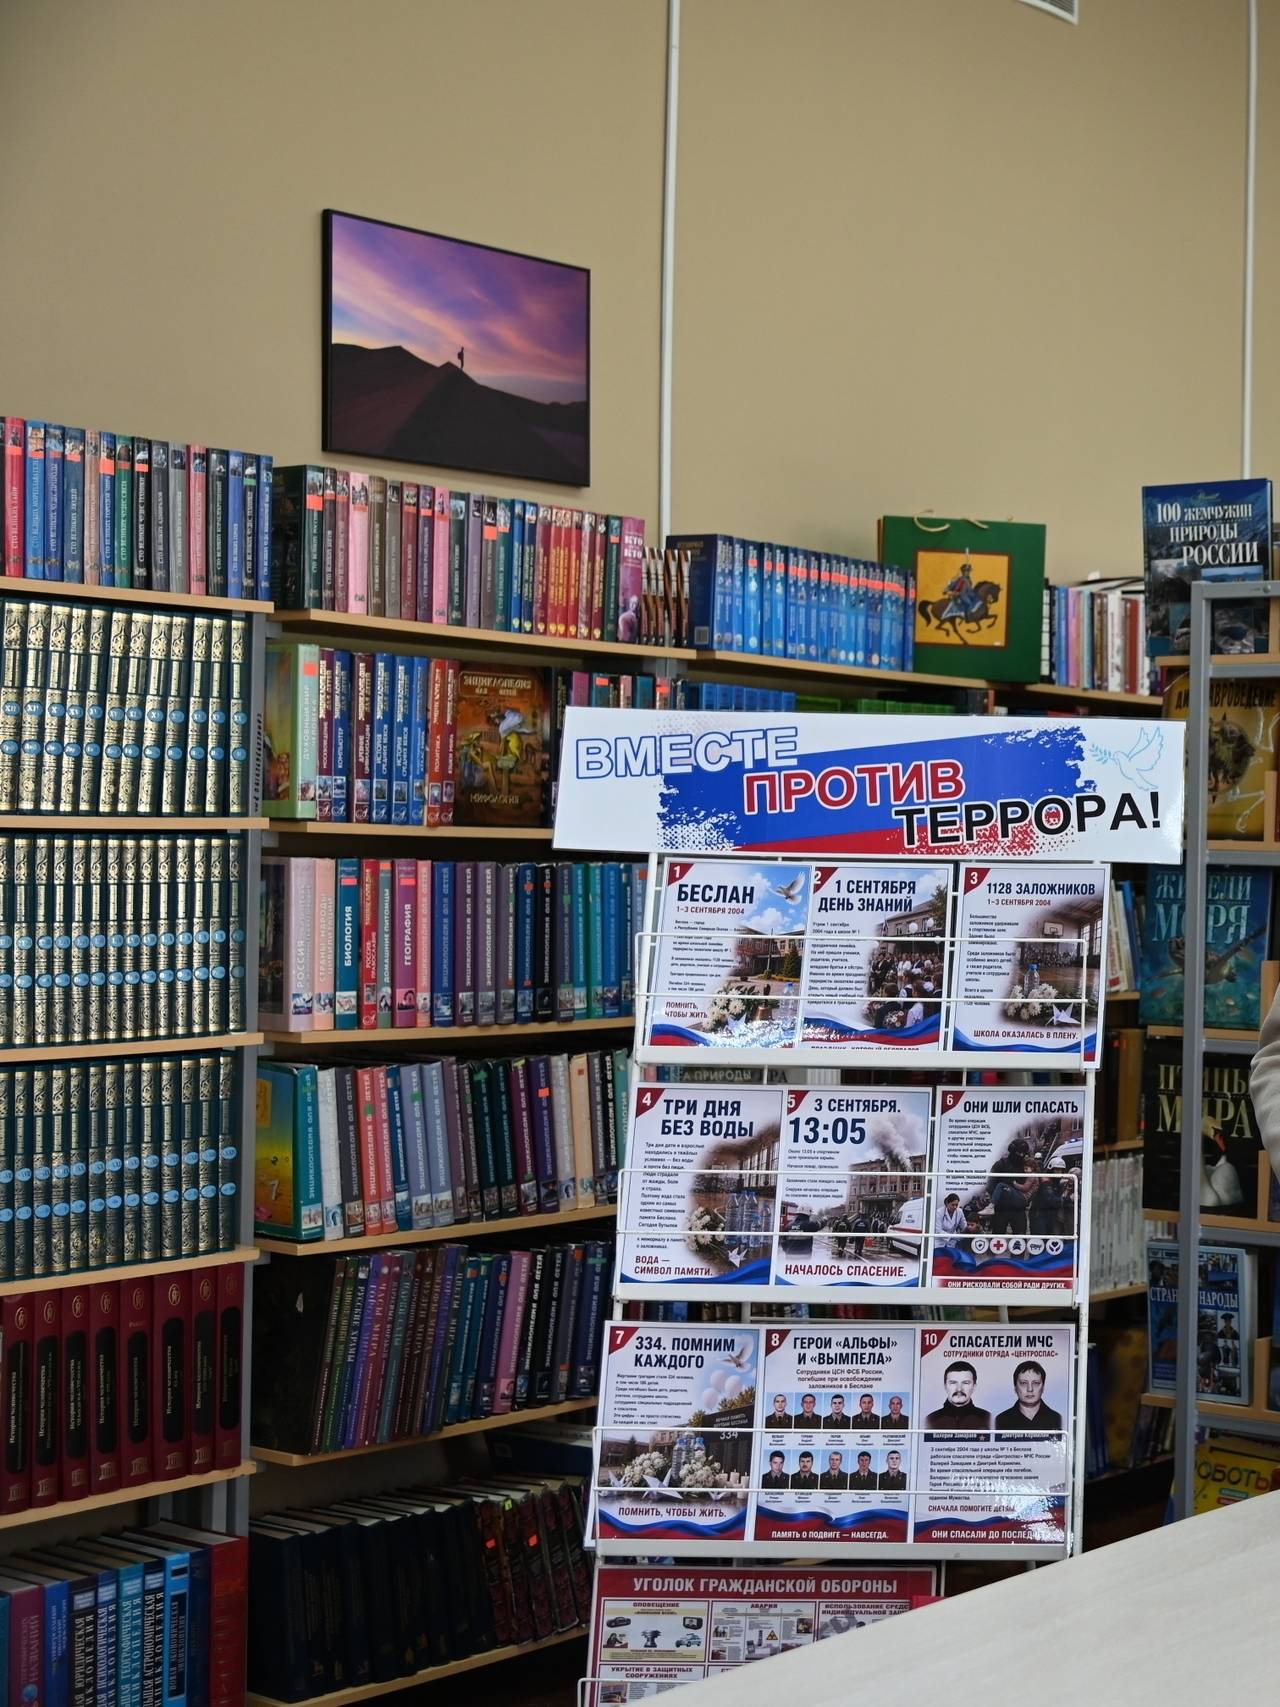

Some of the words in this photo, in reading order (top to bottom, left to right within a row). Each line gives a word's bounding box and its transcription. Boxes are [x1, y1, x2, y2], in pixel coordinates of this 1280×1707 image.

[1156, 502, 1182, 524] 100
[1184, 503, 1253, 522] ЖЕМЧУЖИН
[1169, 523, 1239, 543] ПРИРОДЫ
[1182, 541, 1260, 567] РОССИИ
[575, 727, 798, 779] ВМЕСТЕ
[744, 758, 966, 815] ПРОТИВ
[892, 791, 1162, 848] ТЕРРОРА!
[673, 864, 681, 879] 1
[813, 870, 822, 885] 2
[970, 871, 979, 885] 3
[677, 883, 755, 904] БЕСЛАН
[835, 880, 841, 894] 1
[846, 880, 917, 895] СЕНТЯБРЯ
[986, 882, 1012, 895] 1128
[1015, 882, 1096, 896] ЗАЛОЖНИКОВ
[690, 906, 726, 914] СЕНТЯБРЯ
[818, 897, 854, 913] ДЕНЬ
[857, 896, 913, 912] ЗНАНИЙ
[344, 905, 353, 967] БИОЛОГИЯ
[403, 903, 412, 966] ГЕОГРАФИЯ
[664, 1010, 687, 1018] ЧТОБЫ
[973, 1029, 999, 1038] ШКОЛА
[1001, 1030, 1044, 1039] ОКАЗАЛАСЬ
[1052, 1031, 1078, 1040] ПЛЕНУ.
[642, 1092, 652, 1106] 4
[788, 1094, 796, 1108] 5
[814, 1098, 823, 1112] 3
[828, 1098, 901, 1113] СЕНТЯБРЯ.
[946, 1093, 954, 1106] 6
[664, 1099, 698, 1116] ТРИ
[703, 1100, 741, 1118] ДНЯ
[963, 1100, 988, 1113] ОНИ
[992, 1101, 1021, 1113] ШЛИ
[1025, 1101, 1079, 1113] СПАСАТЬ
[661, 1119, 694, 1136] БЕЗ
[700, 1120, 753, 1139] ВОДЫ
[789, 1116, 866, 1145] 13:05
[635, 1255, 659, 1265] ВОДА
[634, 1266, 672, 1275] СИМВОЛ
[674, 1267, 714, 1276] ПАМЯТИ.
[785, 1264, 843, 1276] НАЧАЛОСЬ
[846, 1265, 907, 1277] СПАСЕНИЕ.
[962, 1281, 1000, 1289] РИСКОВАЛИ
[1001, 1280, 1023, 1289] СОБОЙ
[1199, 1289, 1239, 1309] НАРОДЫ
[615, 1330, 625, 1344] 7
[635, 1336, 667, 1350] 334.
[671, 1337, 736, 1352] ПОМНИМ
[771, 1333, 780, 1347] 8
[793, 1337, 832, 1349] ГЕРОИ
[835, 1336, 898, 1349] «АЛЬФЫ»
[923, 1333, 938, 1346] 10
[950, 1335, 1022, 1348] СПАСАТЕЛИ
[1026, 1335, 1054, 1348] МЧС
[797, 1353, 806, 1365] И
[810, 1352, 892, 1365] «ВЫМПЕЛА»
[943, 1350, 984, 1358] СОТРУДНИКИ
[985, 1350, 1010, 1358] ОТРЯДА
[634, 1354, 705, 1370] КАЖДОГО
[796, 1369, 831, 1377] Сотрудники
[618, 1507, 663, 1517] ПОМНИТЬ,
[665, 1508, 696, 1517] ЧТОБЫ
[699, 1508, 727, 1518] ЖИТЬ.
[771, 1530, 801, 1539] ПАМЯТЬ
[809, 1531, 841, 1540] ПОДВИГЕ
[851, 1530, 889, 1540] НАВСЕГДА.
[931, 1530, 949, 1538] ОНИ
[950, 1530, 987, 1539] СПАСАЛИ
[988, 1530, 1000, 1539] ДО
[633, 1576, 695, 1593] УГОЛОК
[699, 1575, 816, 1595] ГРАЖДАНСКОЙ
[820, 1578, 898, 1594] ОБОРОНЫ
[611, 1666, 644, 1674] УКРЫТИЕ
